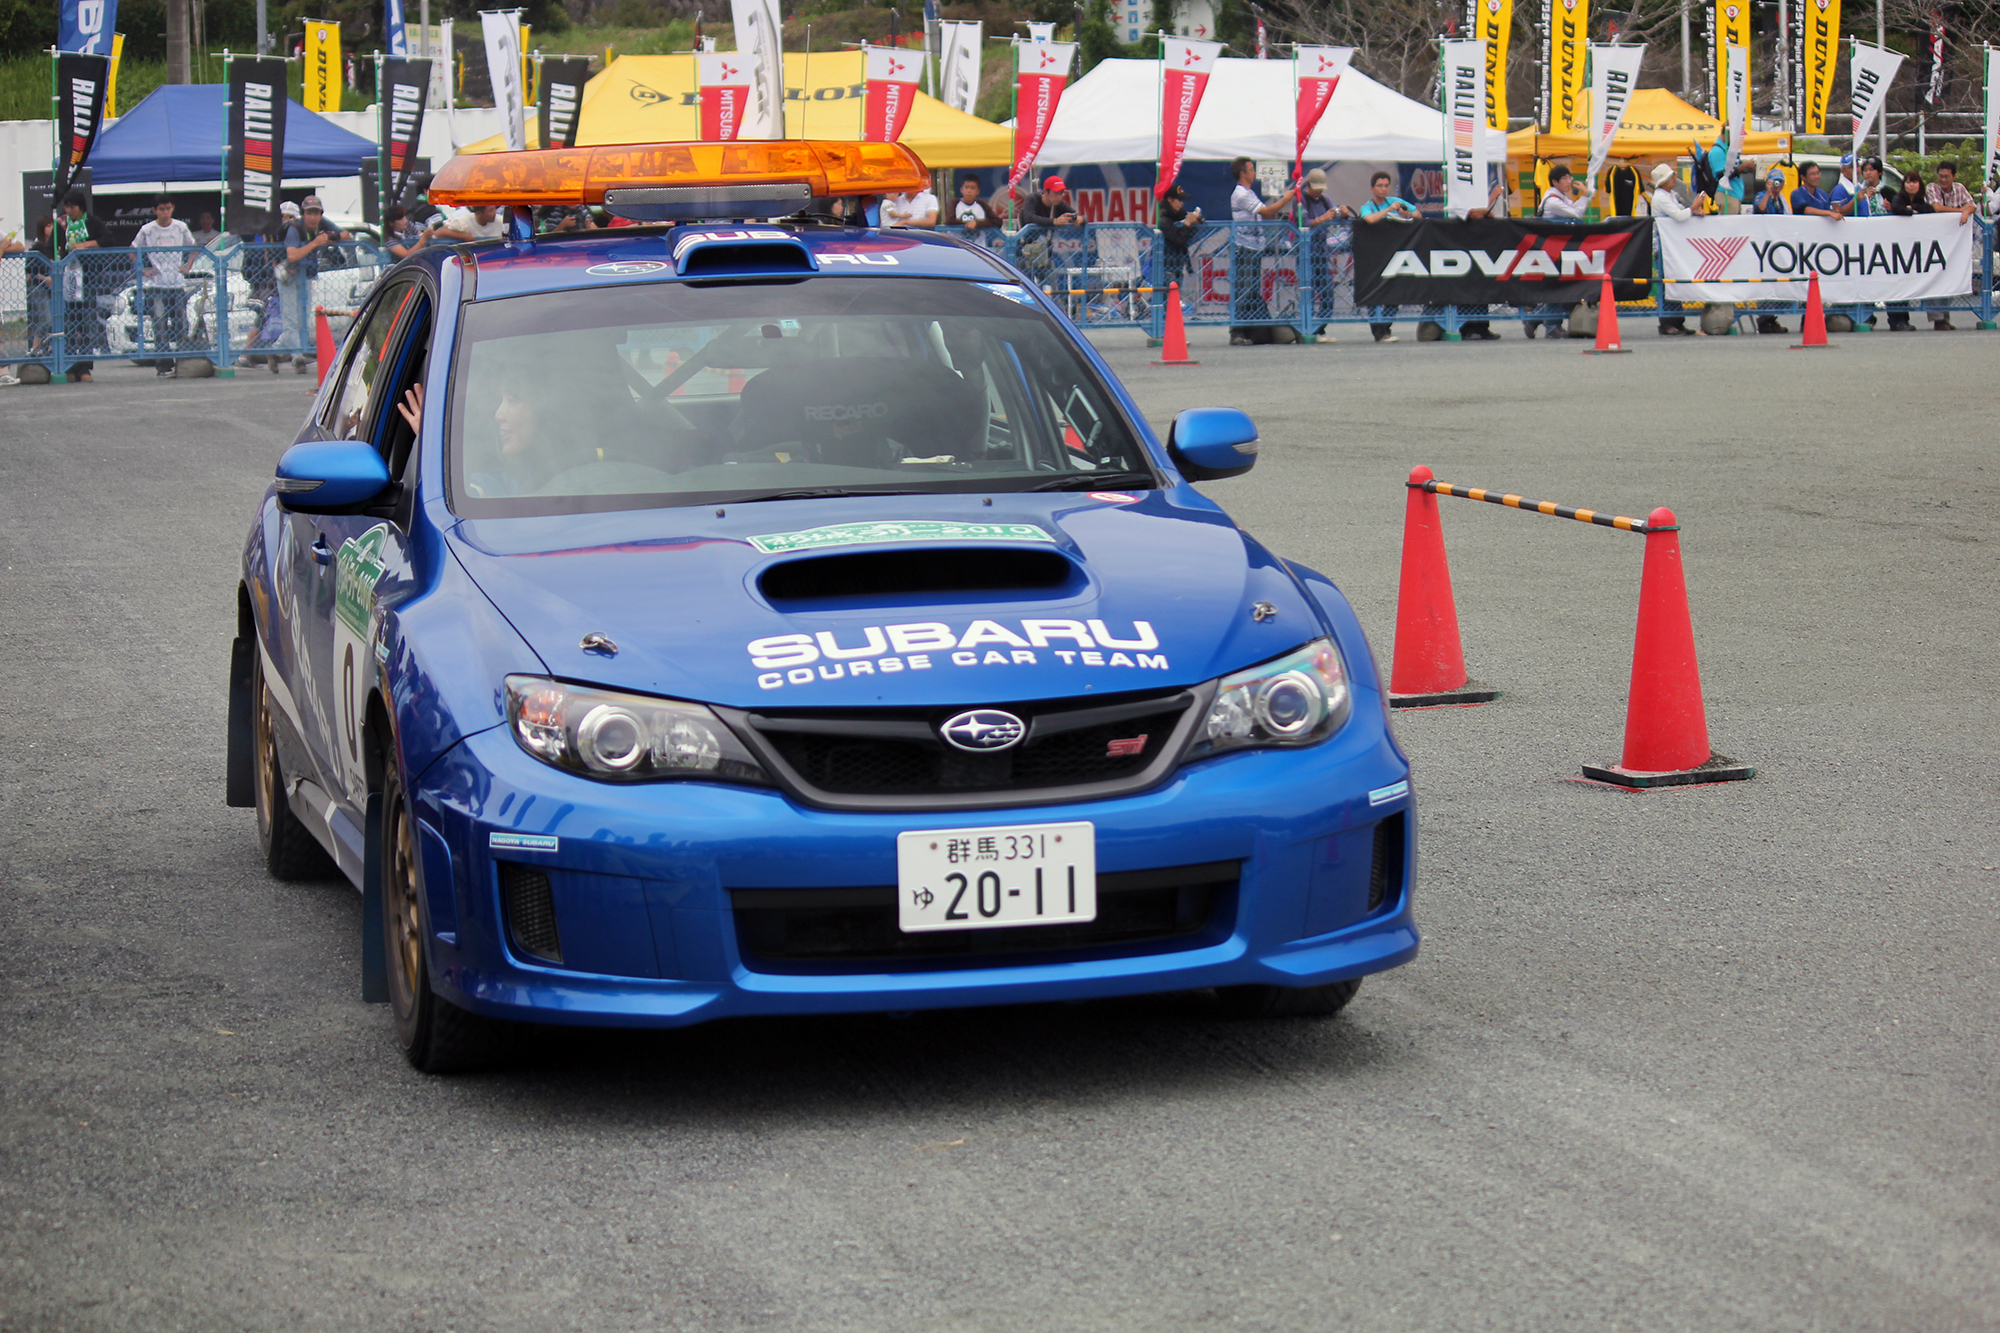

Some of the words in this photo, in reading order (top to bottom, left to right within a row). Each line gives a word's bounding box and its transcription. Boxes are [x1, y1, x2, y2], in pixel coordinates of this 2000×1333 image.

[1454, 66, 1475, 118] RALLI
[1485, 17, 1499, 128] DUNLOP
[1812, 15, 1828, 129] DUNLOP
[550, 82, 577, 140] RALLI
[1175, 74, 1196, 147] MITSUBISHI
[1618, 122, 1715, 131] UNLOP
[1454, 148, 1474, 186] ART
[244, 169, 272, 213] ART
[1380, 250, 1606, 278] ADVAN
[1750, 240, 1947, 276] YOKOHAMA
[804, 402, 888, 420] RECARO
[747, 619, 1160, 669] SUBARU
[757, 654, 932, 690] COURSE
[951, 650, 1038, 667] CAR
[1054, 650, 1169, 670] TEAM
[492, 837, 519, 845] NAGOYA
[521, 839, 555, 847] SUBARU
[912, 886, 934, 910] ゆ
[944, 865, 1076, 921] 20-11
